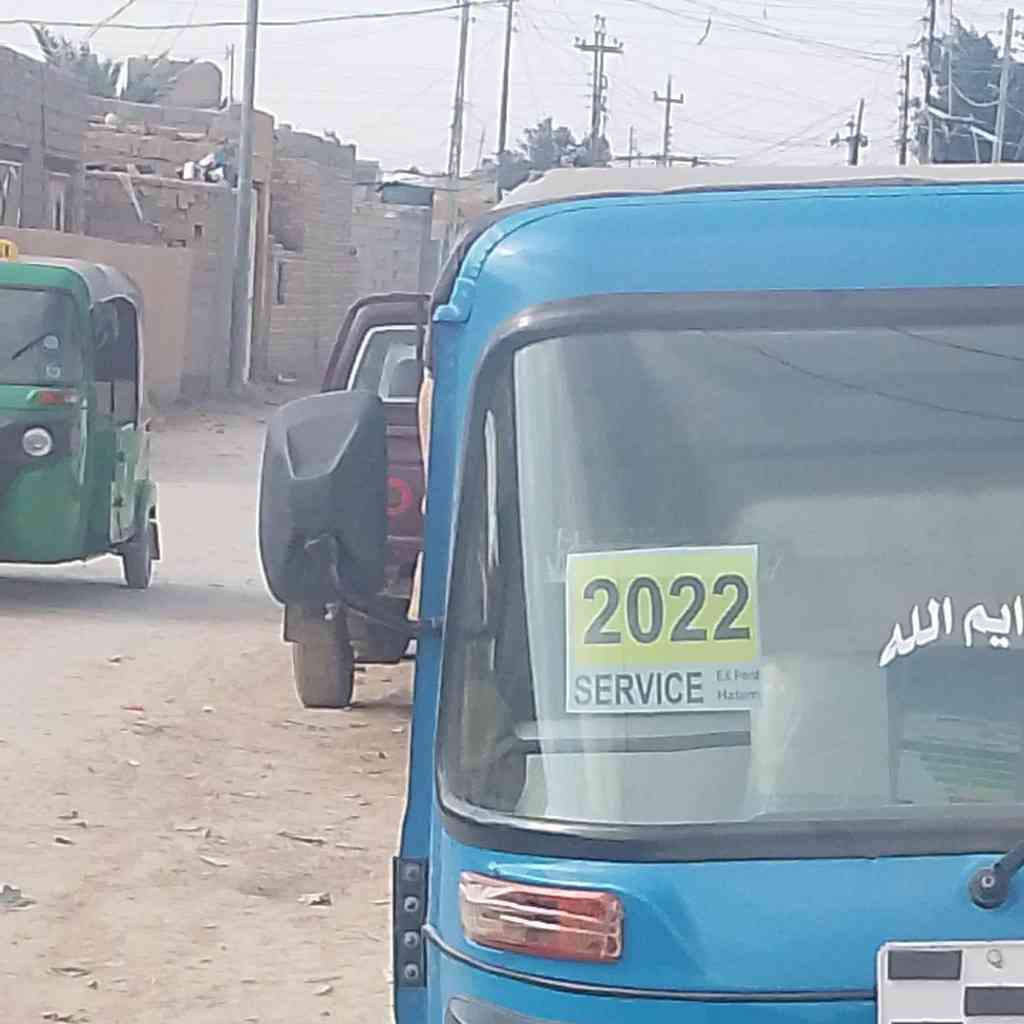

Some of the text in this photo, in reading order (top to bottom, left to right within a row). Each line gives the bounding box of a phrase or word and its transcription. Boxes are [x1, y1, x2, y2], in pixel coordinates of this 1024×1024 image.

[583, 573, 751, 645] 2022
[879, 596, 952, 667] الله
[574, 671, 704, 706] SERVICE
